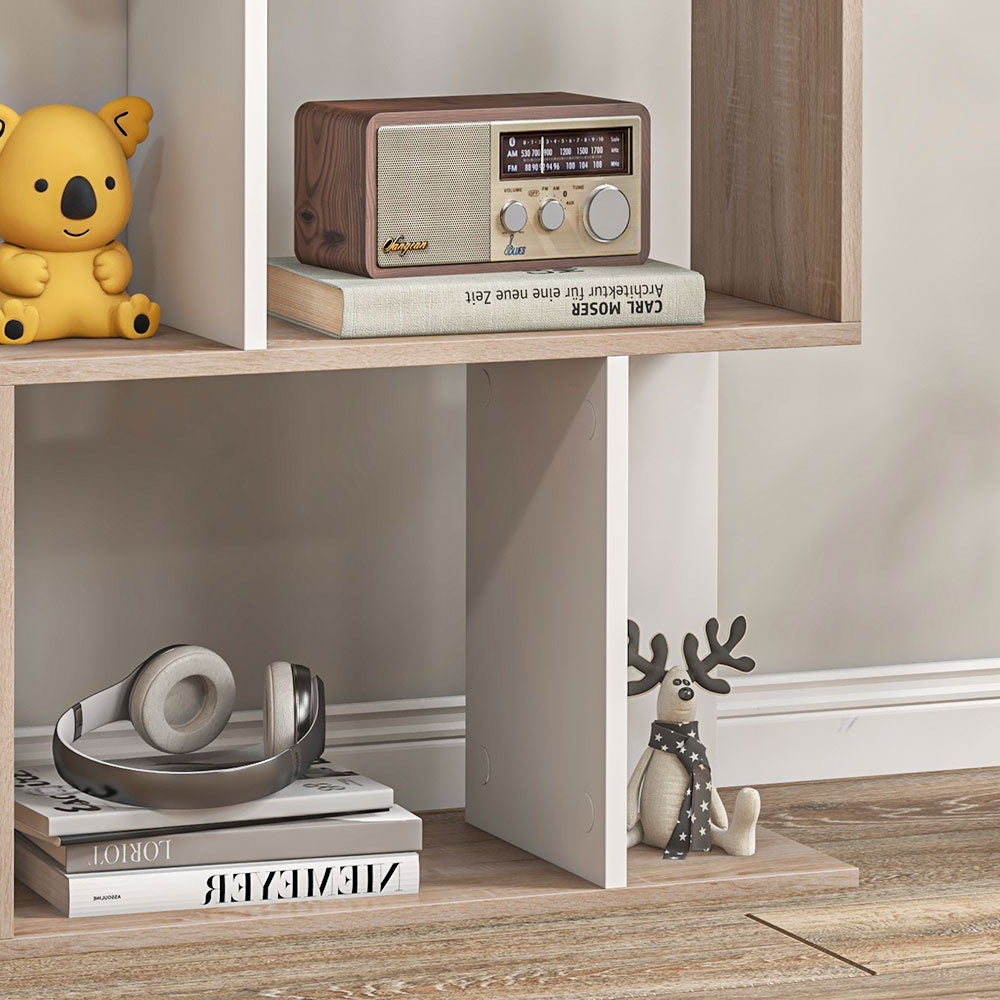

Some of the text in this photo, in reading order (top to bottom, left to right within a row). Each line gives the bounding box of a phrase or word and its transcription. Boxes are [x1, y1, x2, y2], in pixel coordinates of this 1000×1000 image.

[507, 150, 518, 158] AM
[520, 149, 531, 158] 530
[559, 147, 572, 156] 1200
[576, 146, 589, 155] 1500
[590, 146, 604, 154] 1700
[507, 164, 518, 172] FM
[565, 161, 576, 170] 100
[465, 283, 664, 306] Architektur für eine neue Zeit
[571, 299, 663, 316] CARL MOSER
[88, 839, 172, 866] LORIOT
